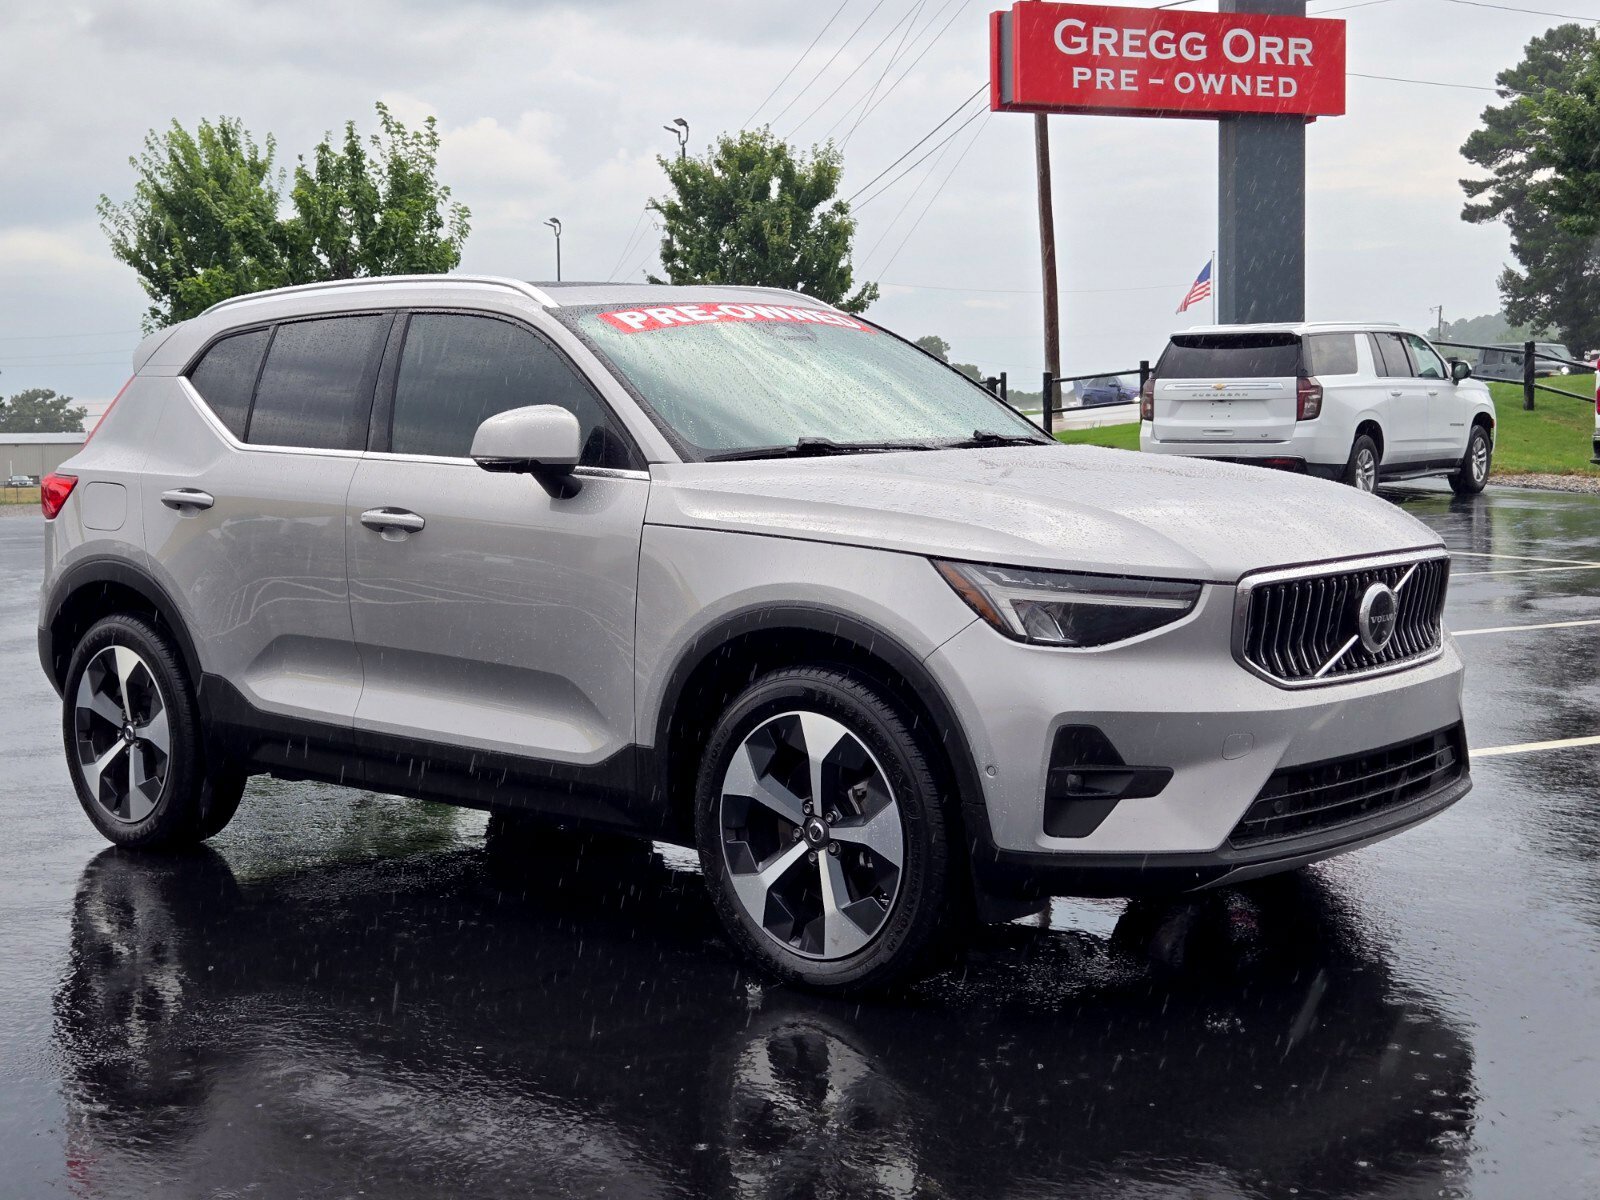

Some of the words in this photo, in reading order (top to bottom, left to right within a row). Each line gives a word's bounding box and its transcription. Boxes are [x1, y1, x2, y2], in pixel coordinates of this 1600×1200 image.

[1053, 18, 1208, 61] GREGG
[1222, 28, 1315, 67] ORR
[1174, 71, 1299, 98] OWNED
[612, 304, 863, 330] PRE-OWNED
